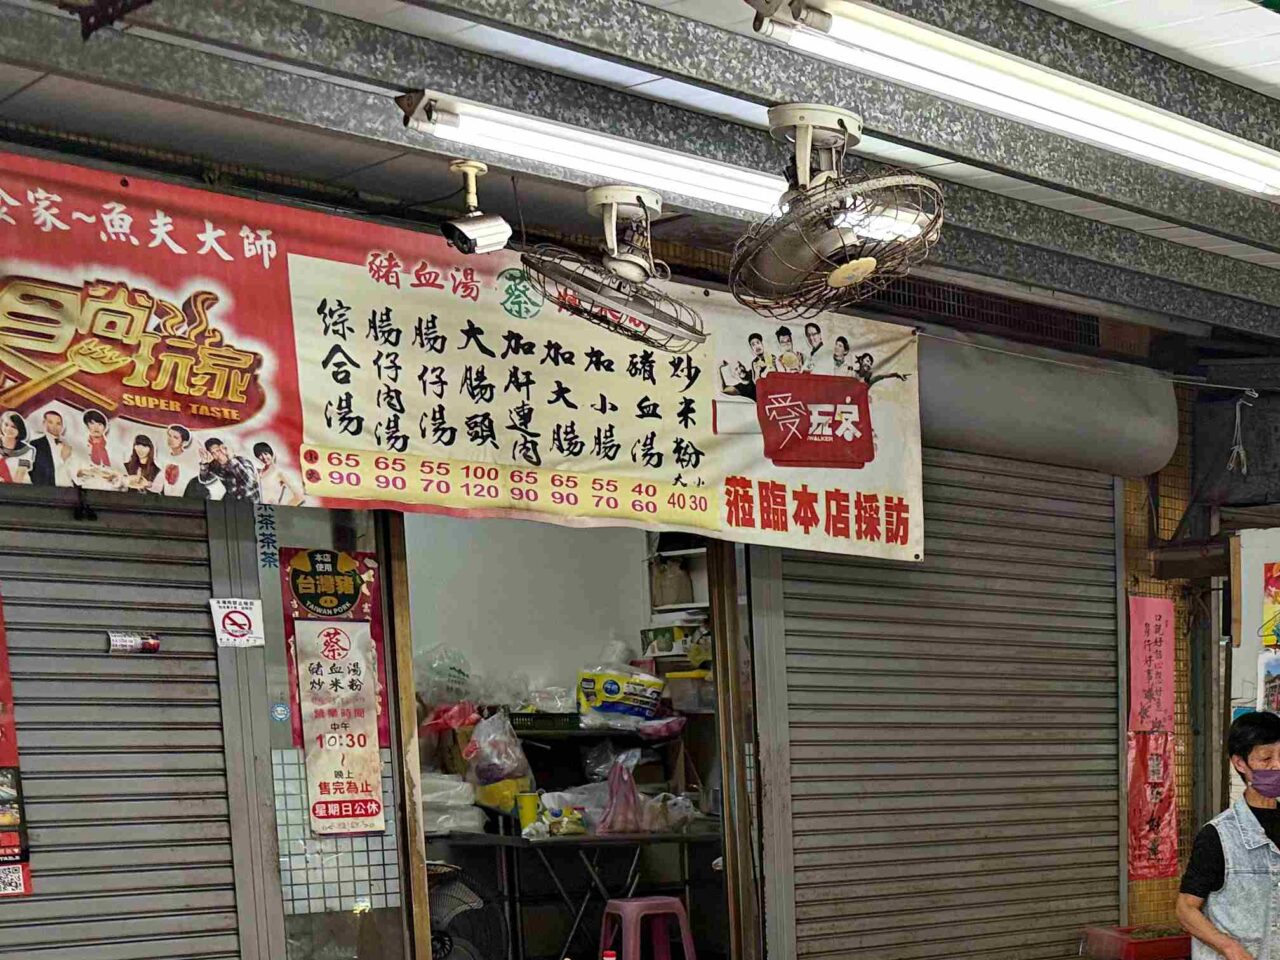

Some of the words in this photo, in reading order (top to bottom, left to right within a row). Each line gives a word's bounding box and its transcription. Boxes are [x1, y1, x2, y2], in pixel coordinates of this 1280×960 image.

[367, 251, 481, 302] 豬血湯
[498, 268, 543, 318] 蔡
[317, 298, 364, 437] 綜合湯
[366, 308, 410, 453] 腸仔肉湯
[412, 314, 457, 446] 腸仔湯
[457, 319, 499, 450] 大腸頭
[123, 393, 181, 413] SUPER
[191, 403, 241, 421] TASTE
[539, 340, 586, 458] 加大腸
[584, 347, 621, 461] 加小腸
[668, 355, 706, 469] 炒米粉
[327, 452, 361, 468] 65
[374, 456, 406, 472] 65
[420, 460, 450, 476] 55
[461, 465, 499, 481] 100
[510, 470, 538, 485] 65
[550, 474, 578, 489] 65
[591, 478, 619, 492] 55
[631, 483, 657, 497] 40
[673, 473, 687, 487] 大
[328, 471, 361, 487] 90
[375, 475, 407, 490] 90
[420, 479, 450, 494] 70
[460, 483, 499, 498] 120
[510, 487, 538, 502] 90
[551, 491, 579, 506] 90
[592, 496, 619, 509] 70
[631, 499, 657, 513] 60
[667, 492, 686, 510] 40
[689, 495, 708, 512] 30
[724, 475, 910, 545] 蒞臨本店採訪
[314, 553, 331, 562] 本店
[315, 563, 332, 572] 使用
[305, 600, 333, 615] TAIWAN
[333, 601, 352, 614] PORK
[318, 627, 351, 661] 蔡
[309, 678, 364, 692] 炒米粉
[316, 733, 367, 749] 10:30
[330, 722, 350, 732] 中午
[318, 780, 373, 796] 售完為止
[334, 769, 354, 779] 晚上
[314, 801, 379, 817] 星期日公休
